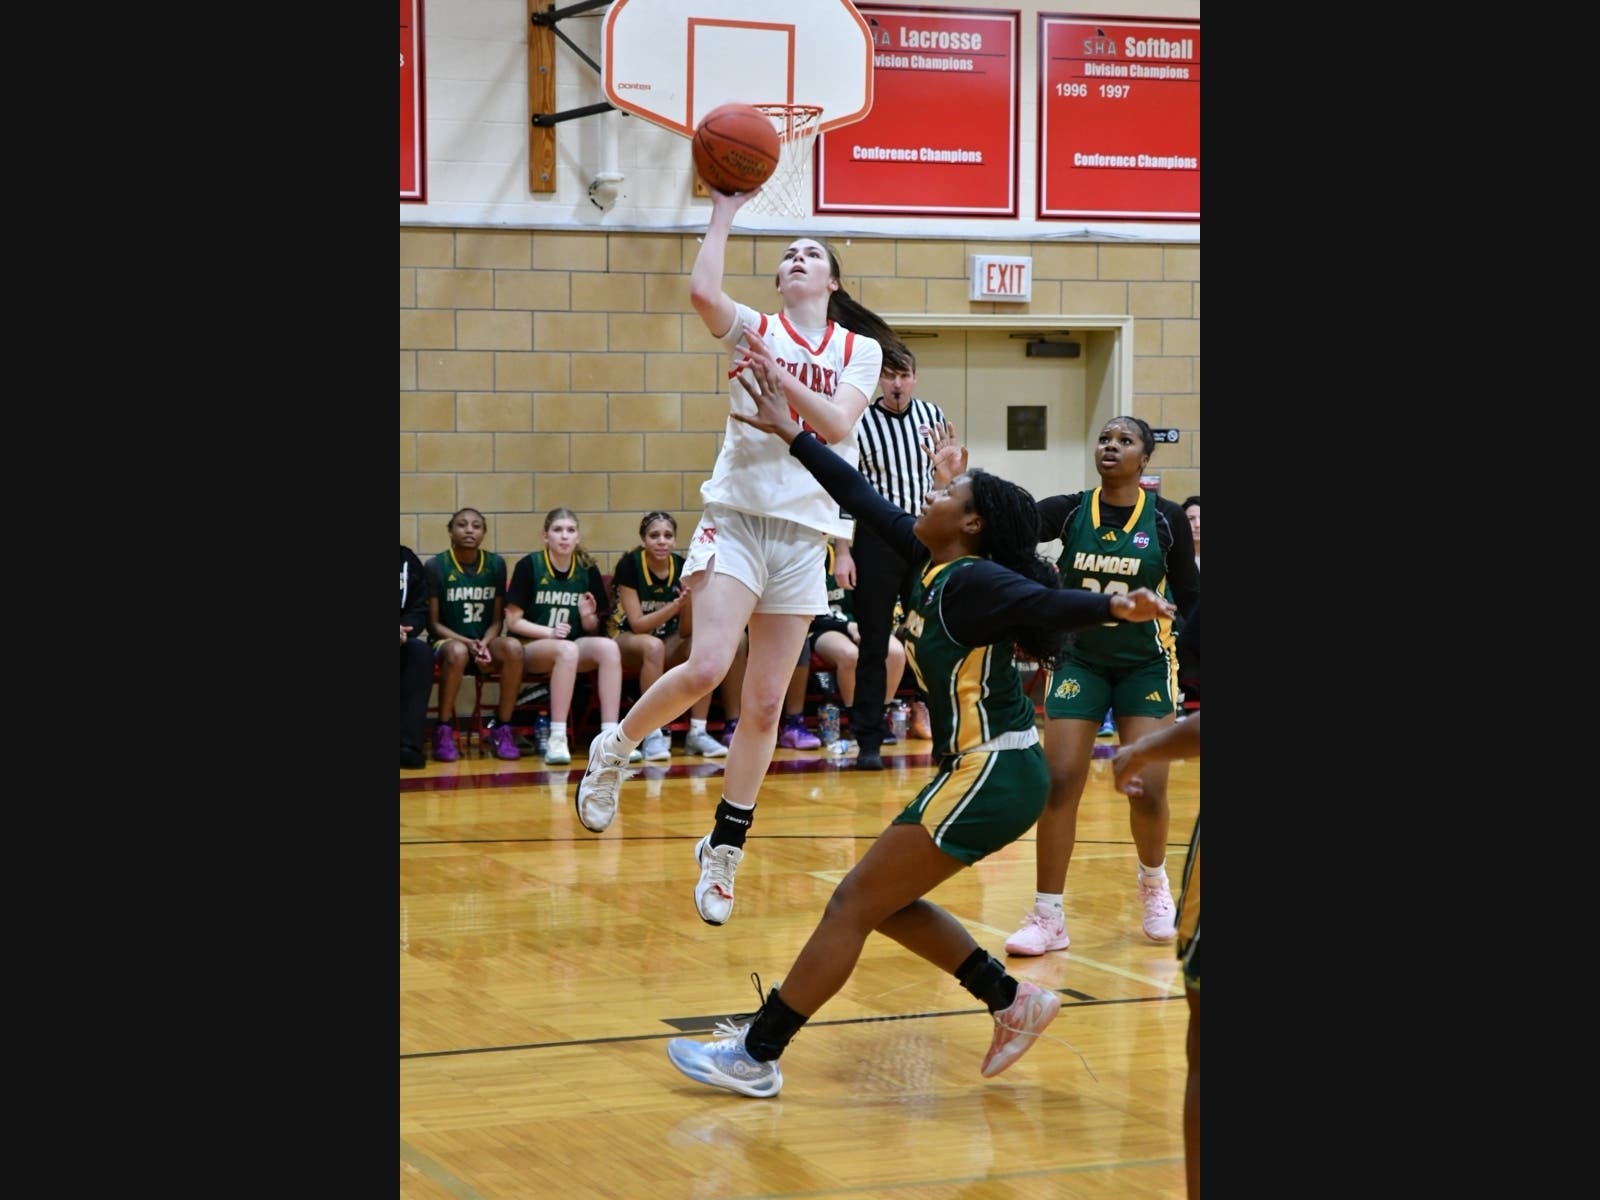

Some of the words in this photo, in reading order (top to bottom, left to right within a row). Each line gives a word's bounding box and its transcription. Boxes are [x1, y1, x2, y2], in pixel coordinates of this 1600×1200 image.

[900, 26, 982, 50] Lacrosse
[1083, 40, 1116, 55] SHA
[1125, 37, 1193, 59] Softball
[874, 54, 909, 67] vision
[911, 55, 973, 71] Champions
[1085, 63, 1127, 77] Division
[1129, 64, 1189, 79] Champions
[1055, 83, 1088, 97] 1996
[1099, 85, 1130, 98] 1997
[853, 145, 918, 162] Conference
[919, 147, 982, 164] Champions
[1074, 152, 1136, 168] Conference
[1137, 154, 1197, 169] Champions
[986, 263, 1026, 294] EXIT
[1073, 552, 1142, 576] HAMDEN
[446, 586, 496, 602] HAMDEN
[463, 602, 485, 623] 32
[548, 607, 570, 628] 10
